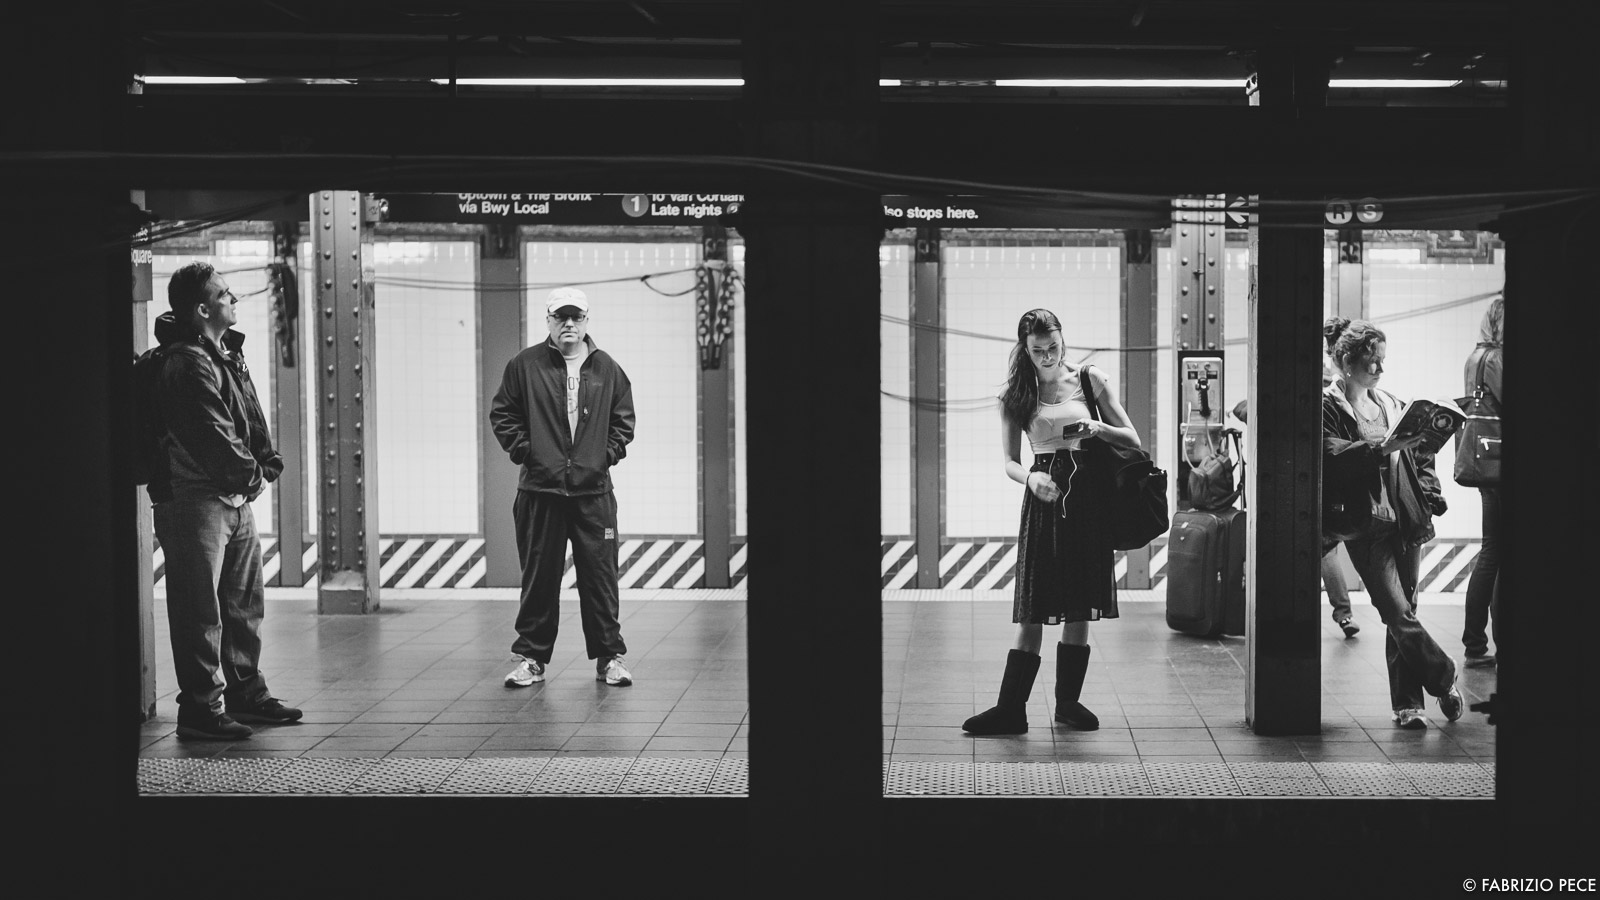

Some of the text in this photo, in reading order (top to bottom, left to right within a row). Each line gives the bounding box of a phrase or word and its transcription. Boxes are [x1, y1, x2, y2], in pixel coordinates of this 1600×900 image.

[458, 201, 550, 216] via Bwy Local
[651, 203, 680, 216] Late
[683, 203, 722, 218] nights
[907, 206, 943, 221] stops
[946, 206, 979, 219] here.
[131, 249, 153, 267] quare
